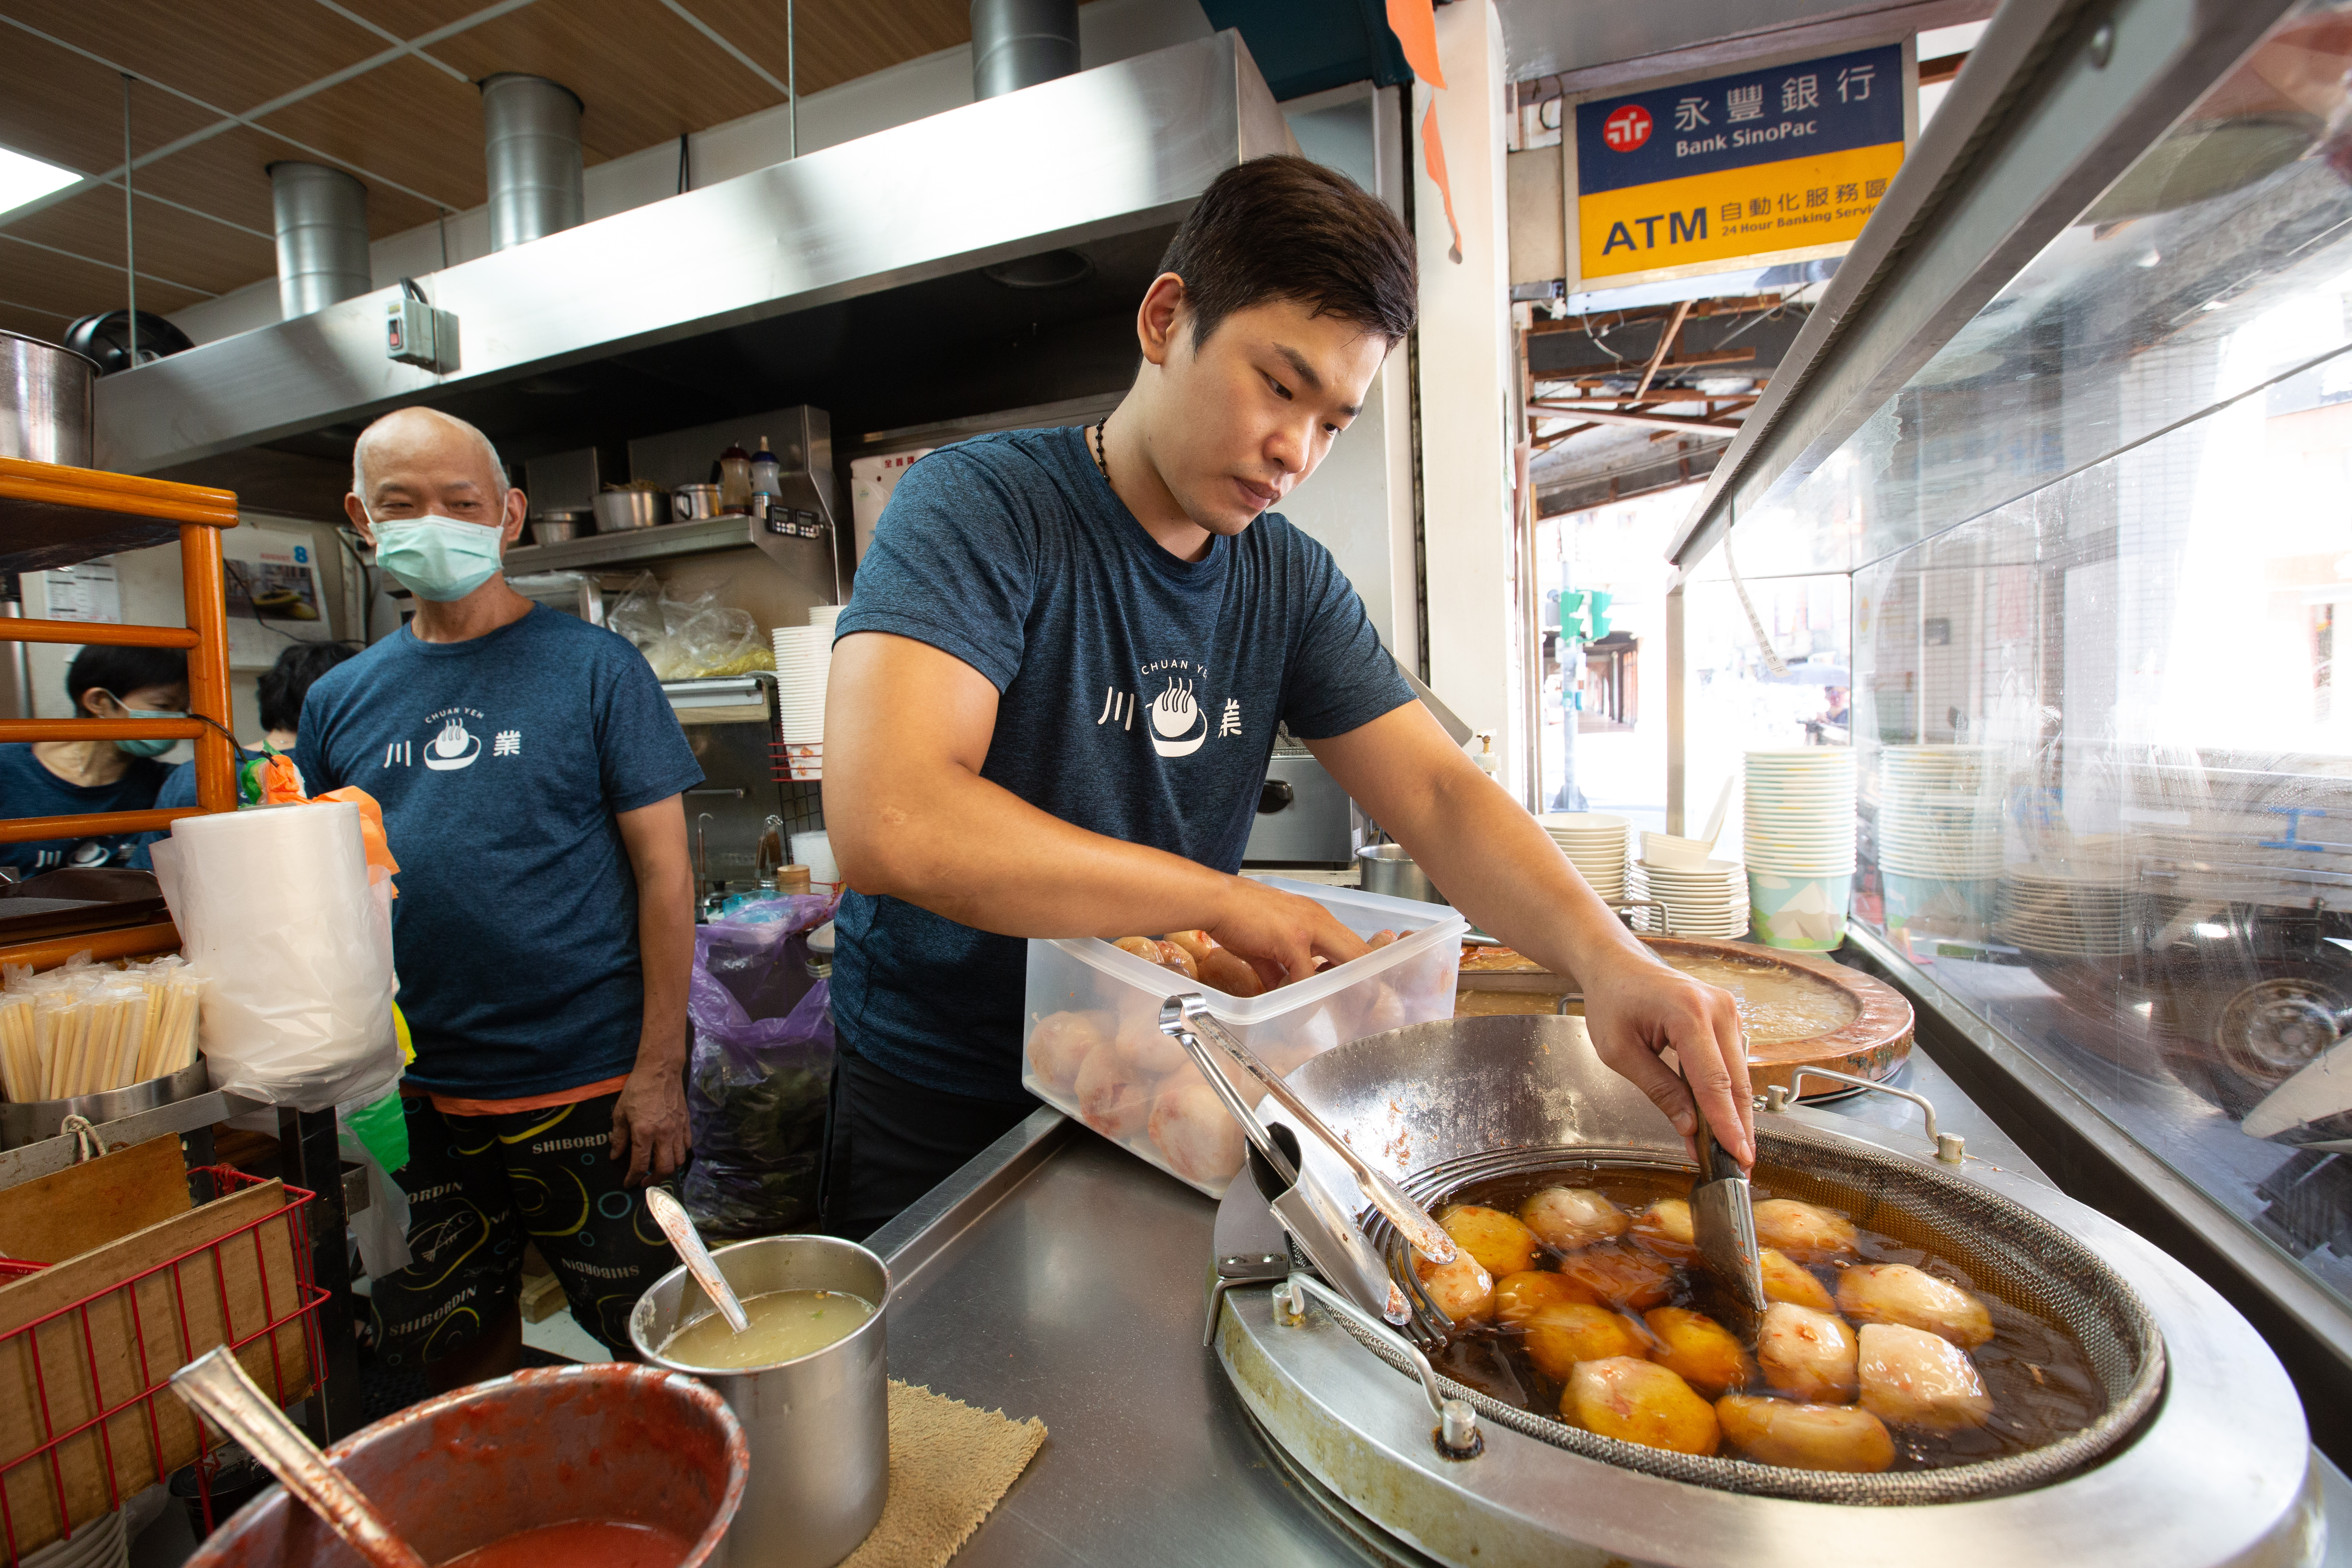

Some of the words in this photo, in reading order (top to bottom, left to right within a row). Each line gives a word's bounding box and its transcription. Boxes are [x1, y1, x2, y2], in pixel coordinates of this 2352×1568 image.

[1675, 65, 1876, 131] 永豐銀行
[1676, 134, 1727, 158] Bank
[1733, 120, 1817, 147] SinoPac
[1721, 178, 1887, 221] 自動化服務區
[1602, 207, 1707, 256] ATM
[1722, 226, 1736, 236] 24
[1741, 220, 1773, 232] Hour
[1777, 211, 1831, 227] Banking
[294, 546, 308, 563] 8
[1142, 659, 1188, 675] CHUAN
[1197, 664, 1207, 682] YE
[425, 707, 460, 724] CHUAN
[464, 707, 484, 719] YEH
[1098, 686, 1134, 731] 川
[383, 740, 411, 768] 川
[493, 730, 521, 757] 業
[561, 1258, 640, 1279] SHIBORDIN
[389, 1285, 477, 1336] SHIBORDIN
